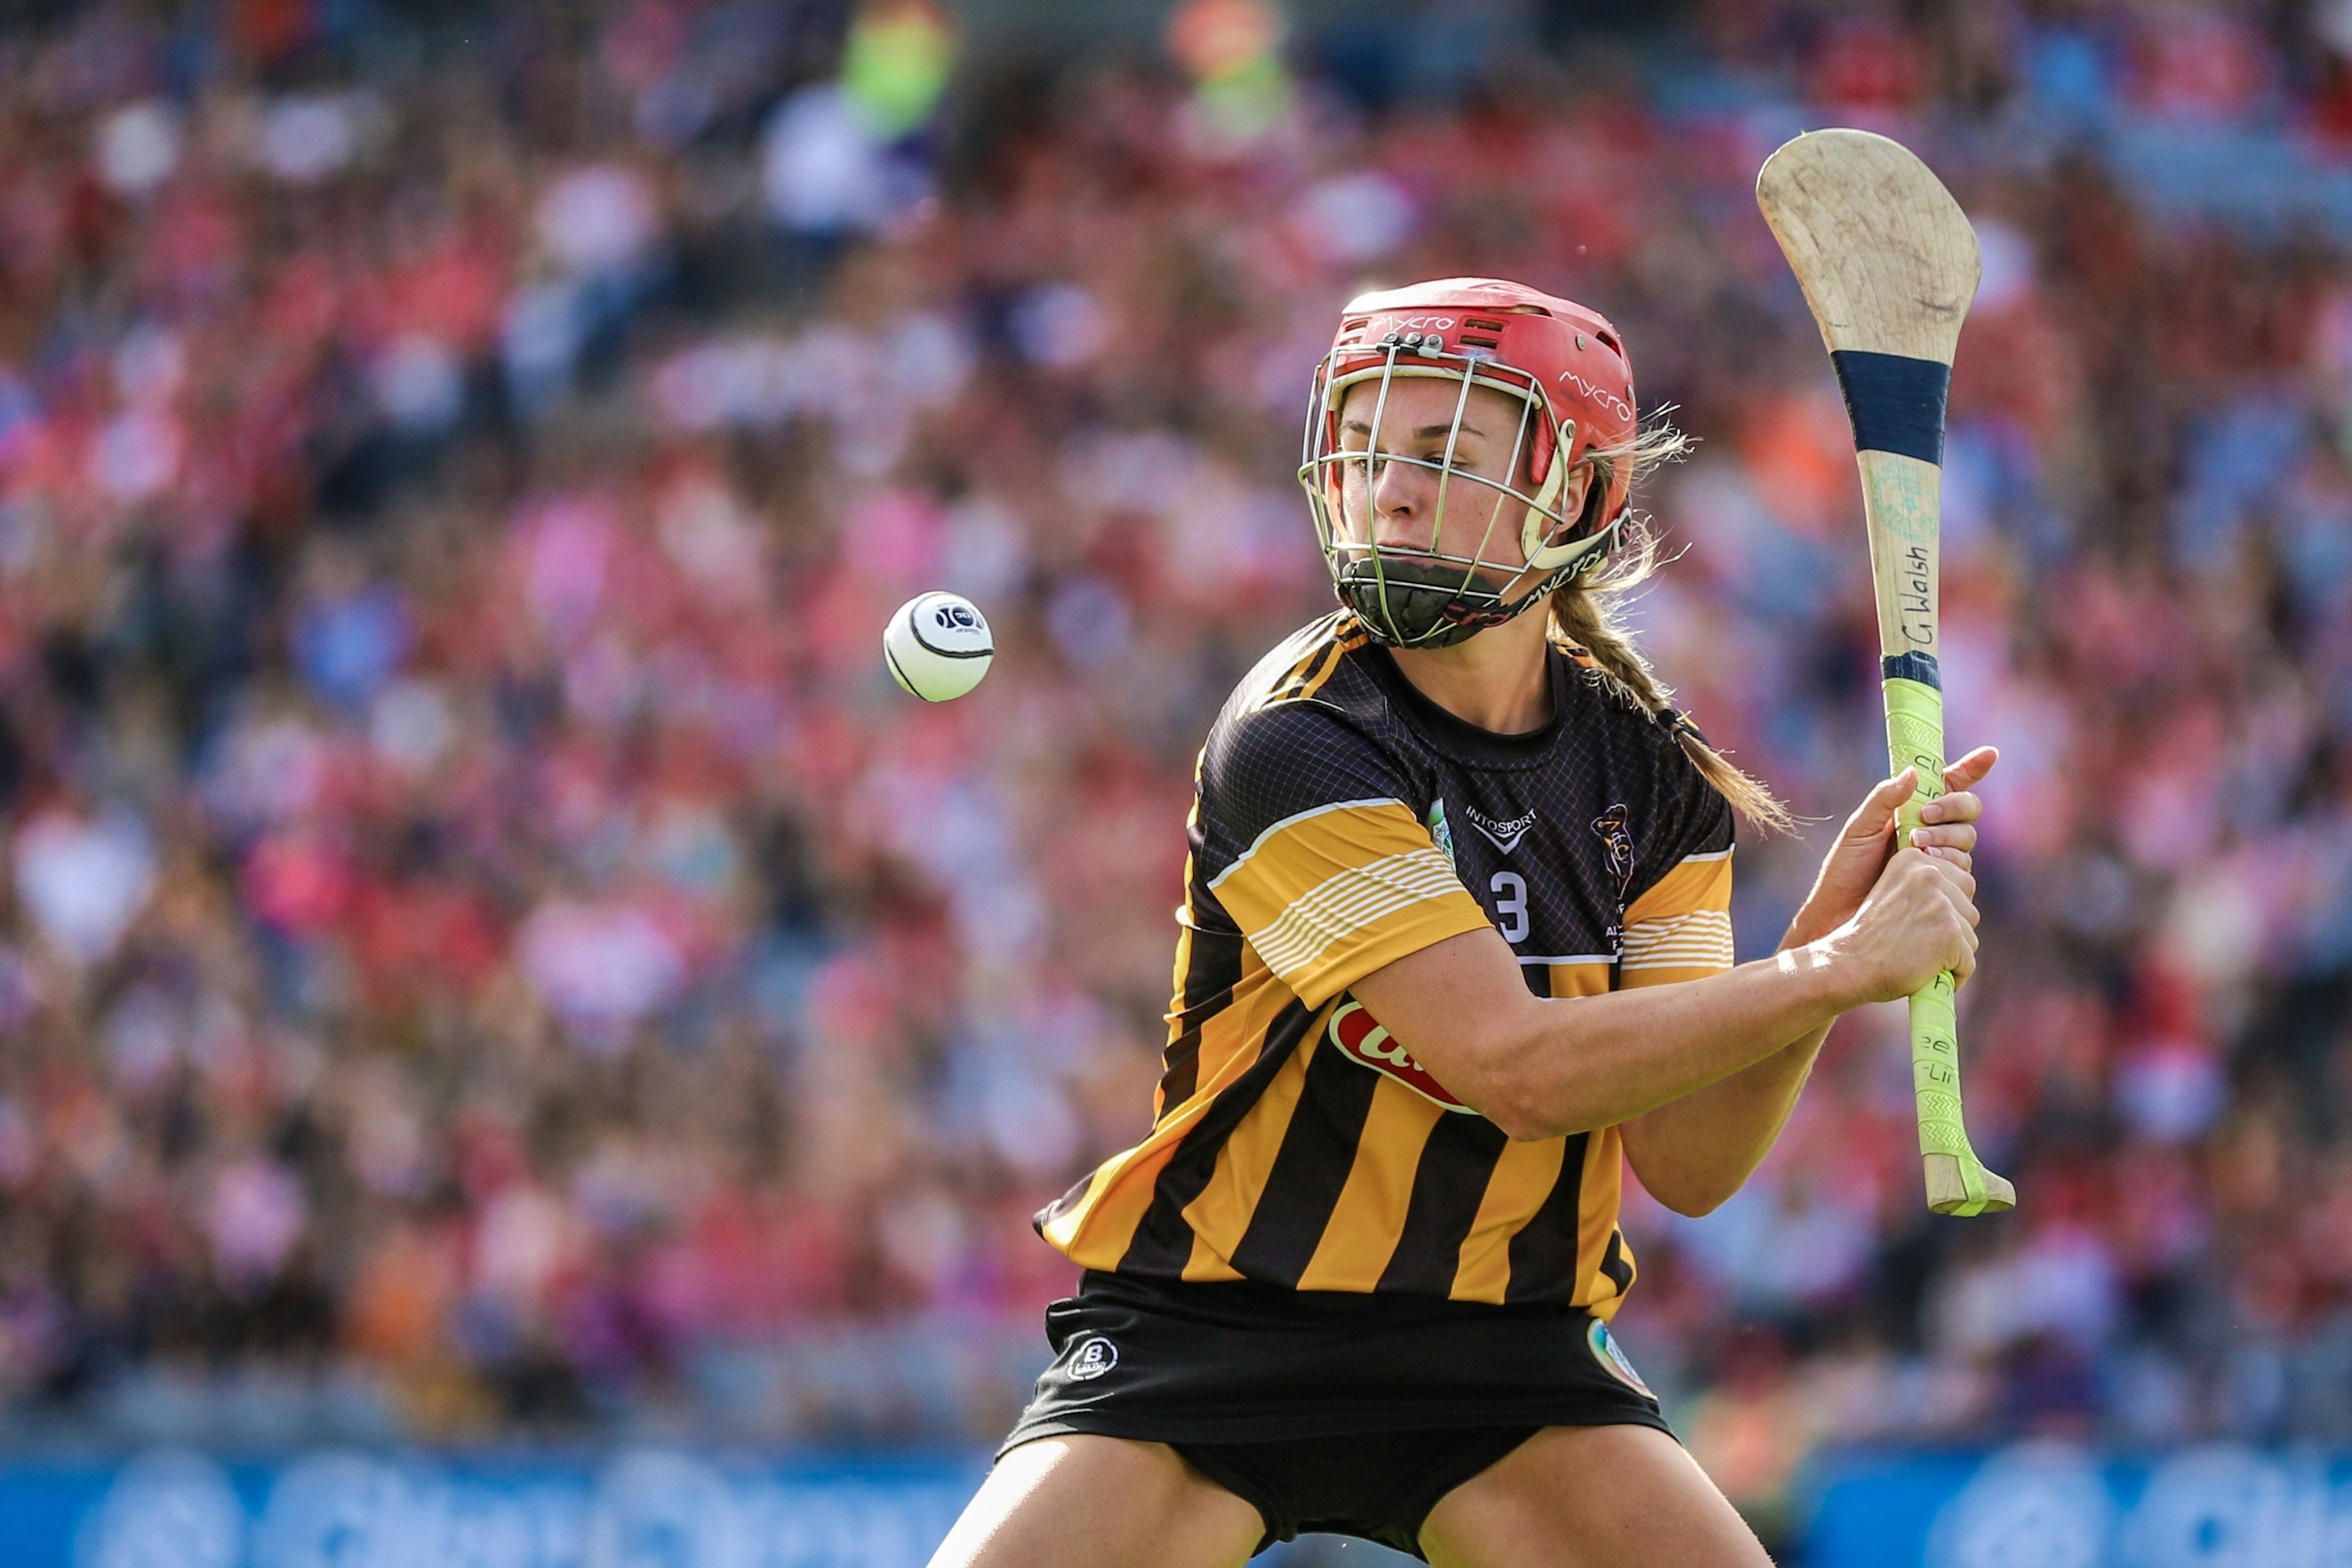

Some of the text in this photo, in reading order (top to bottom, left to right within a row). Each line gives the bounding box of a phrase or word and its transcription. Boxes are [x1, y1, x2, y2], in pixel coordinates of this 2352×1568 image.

[1370, 314, 1455, 332] Mycro
[1899, 546, 1931, 612] Walsh
[1465, 805, 1537, 832] INTOSPORT
[1490, 870, 1531, 944] 3
